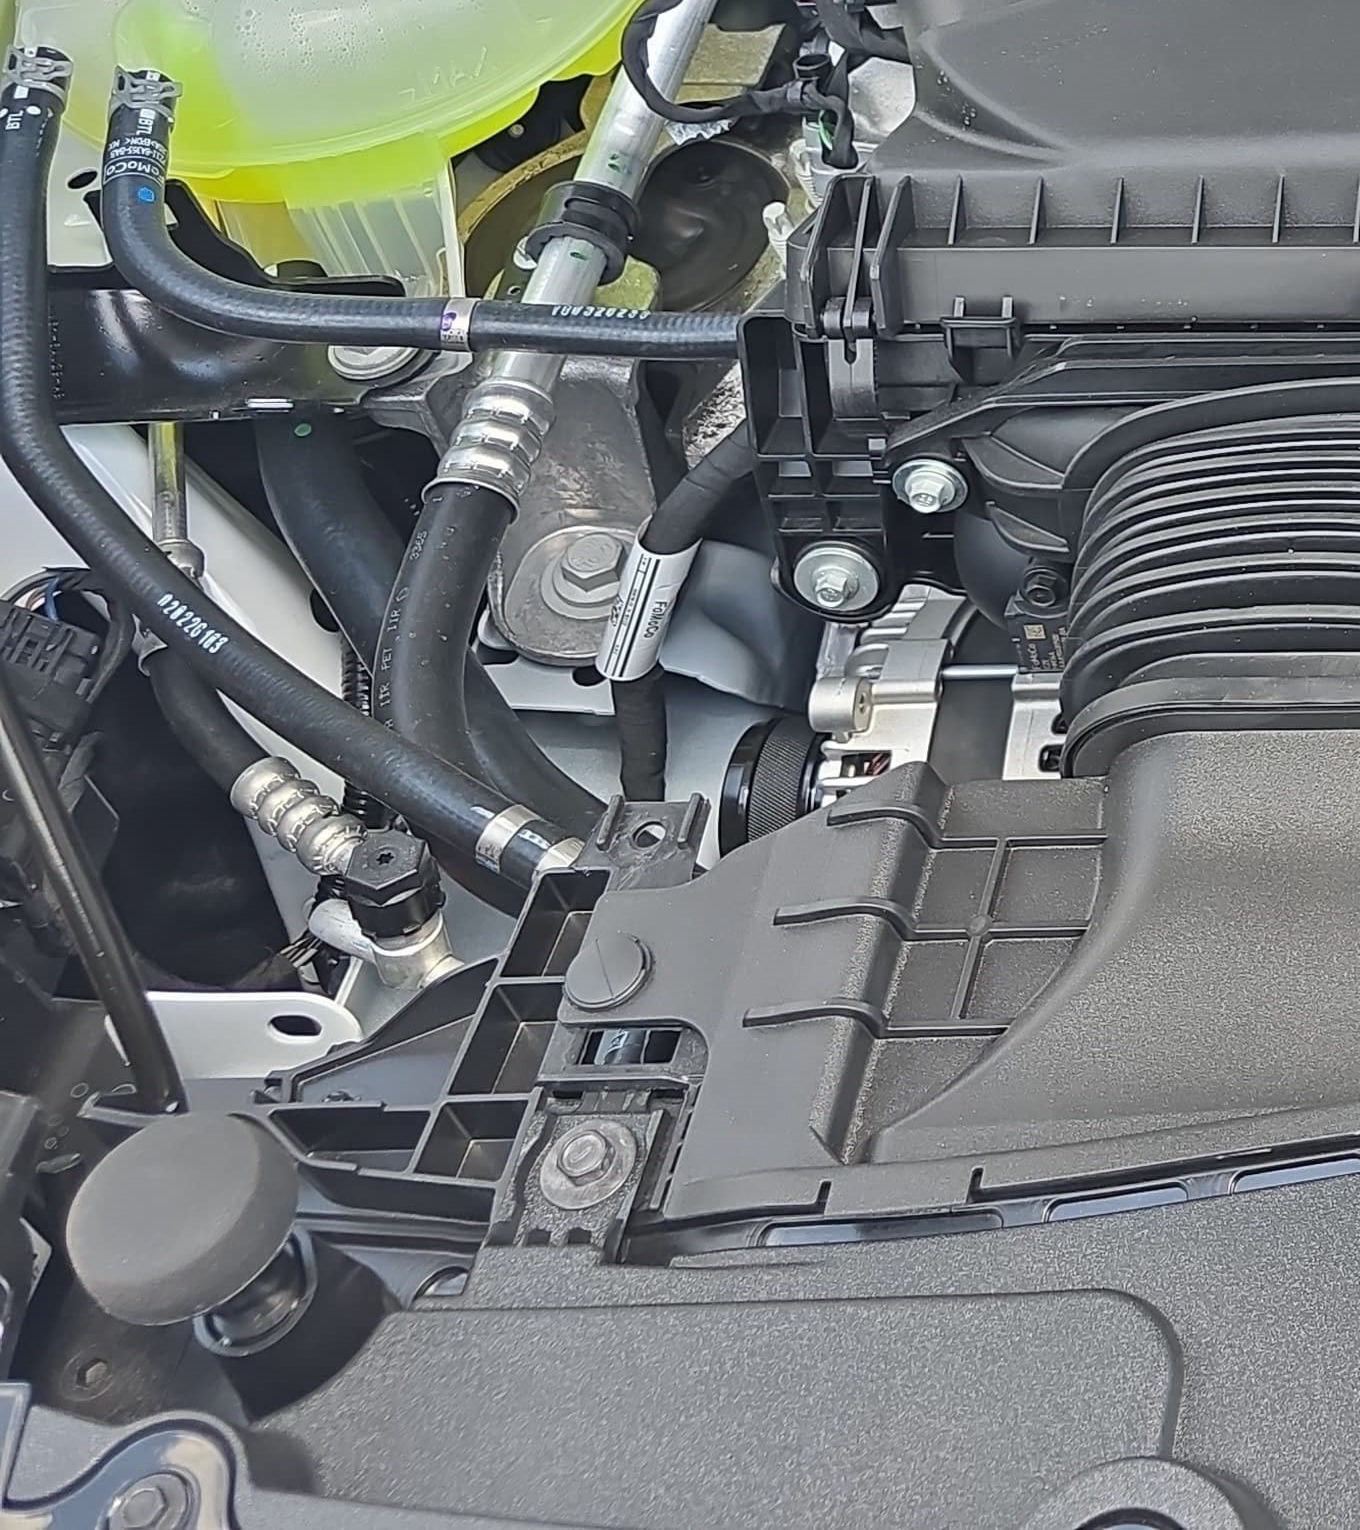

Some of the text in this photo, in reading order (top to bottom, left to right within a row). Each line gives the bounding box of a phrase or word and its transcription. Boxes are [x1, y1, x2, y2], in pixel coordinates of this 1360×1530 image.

[5, 110, 25, 130] BTL
[136, 119, 154, 137] BTL
[643, 600, 668, 641] FoMoCo
[381, 648, 394, 671] PET
